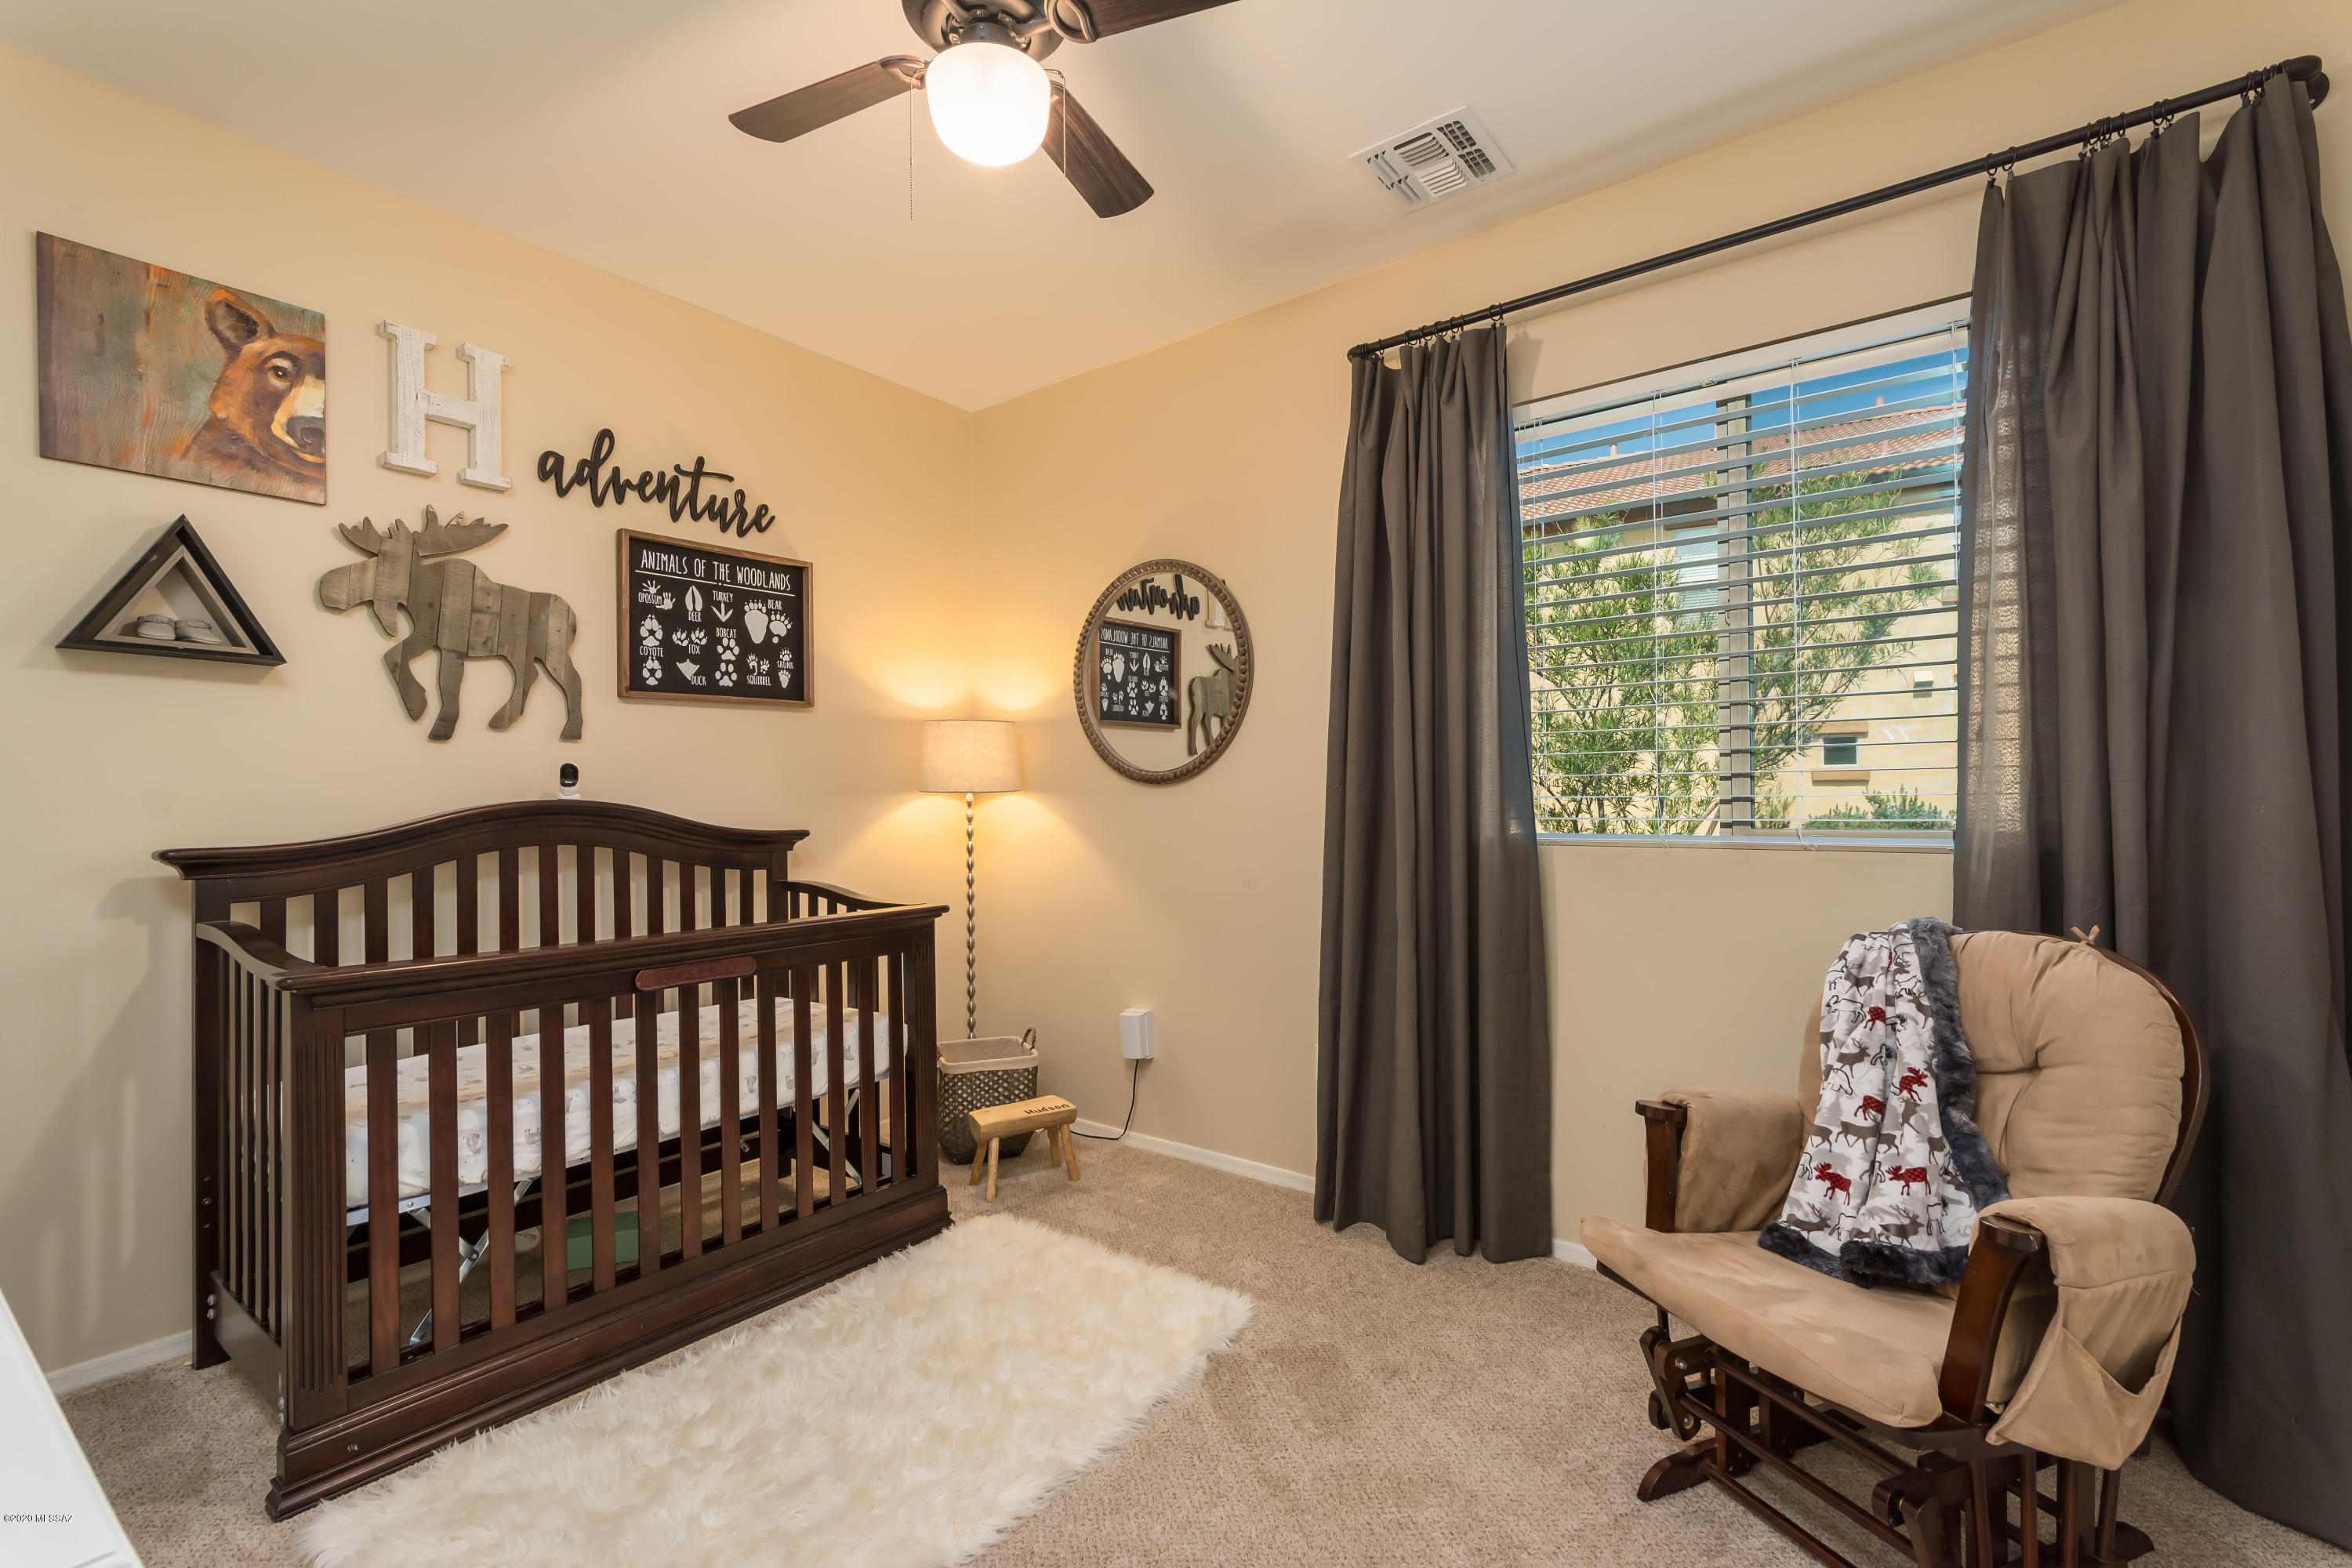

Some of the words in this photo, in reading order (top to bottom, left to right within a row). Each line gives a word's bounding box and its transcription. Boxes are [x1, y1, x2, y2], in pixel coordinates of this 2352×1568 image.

[376, 320, 512, 492] H
[538, 427, 776, 539] adventure
[641, 549, 688, 575] ANIMALS
[694, 557, 706, 578] OF
[713, 561, 731, 583] THE
[736, 565, 791, 591] WOODLANDS
[638, 592, 662, 605] OPOSSUM
[712, 590, 734, 603] TURKEY
[768, 599, 782, 610] BEAR
[688, 612, 702, 622] DEER
[716, 627, 737, 639] BOBCAT
[639, 645, 664, 658] COYOTE
[688, 644, 701, 655] FOX
[777, 660, 794, 670] SKUNK
[691, 674, 706, 686] DUCK
[746, 675, 772, 686] SQUIRREL
[1024, 1103, 1070, 1115] Hudson
